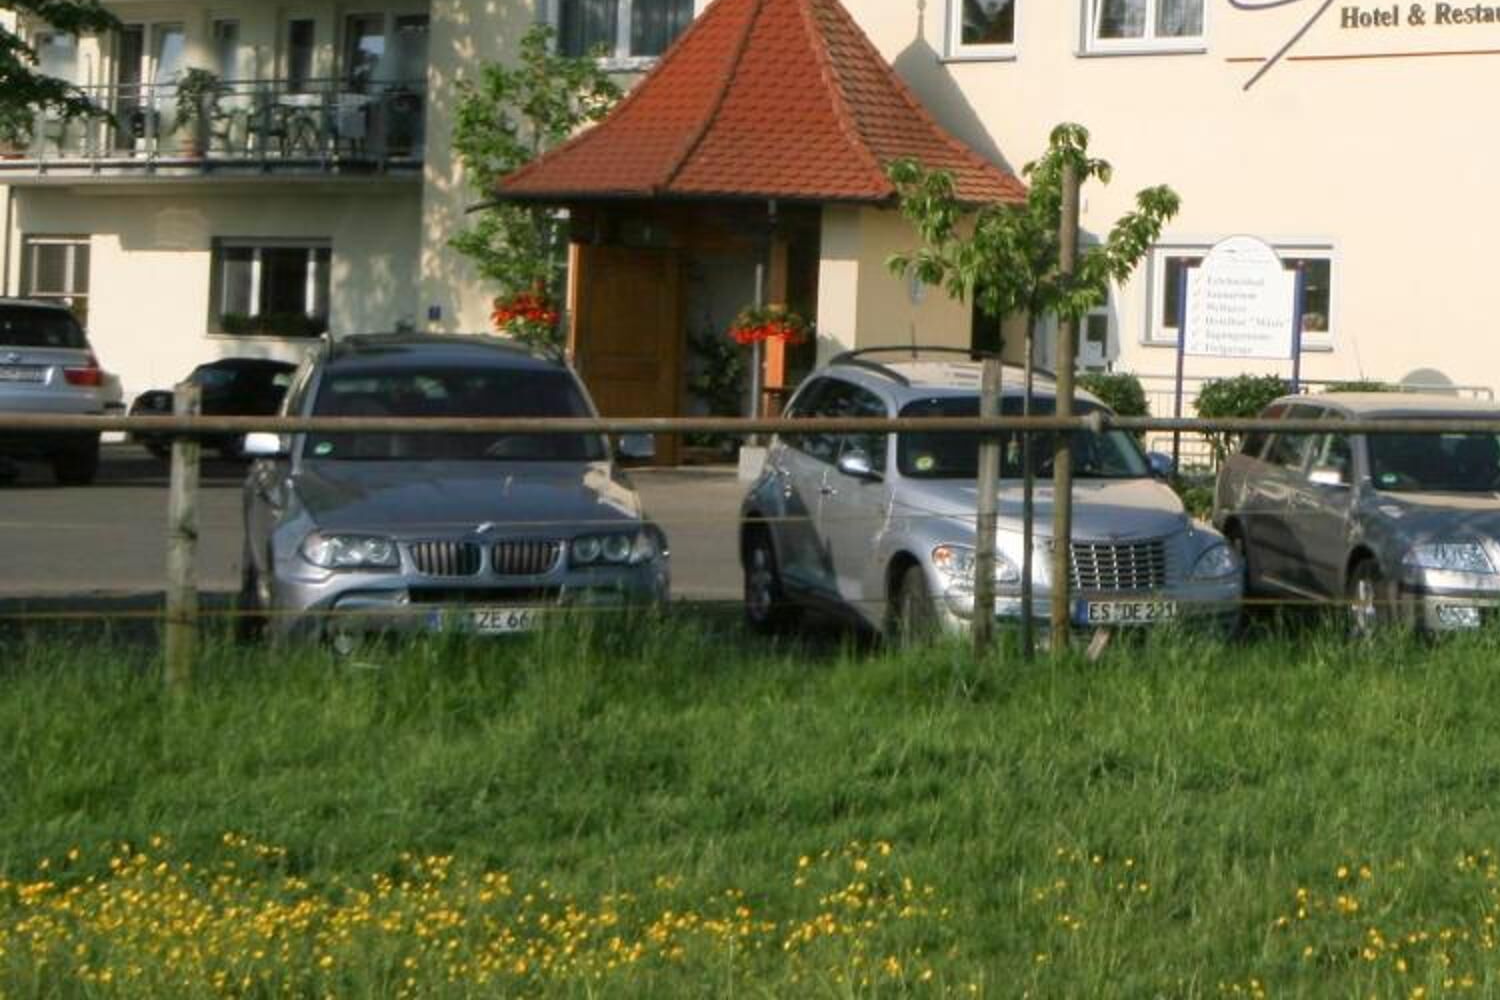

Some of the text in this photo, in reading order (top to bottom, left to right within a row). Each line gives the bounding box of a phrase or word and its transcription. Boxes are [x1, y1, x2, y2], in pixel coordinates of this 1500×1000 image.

[1340, 4, 1399, 29] Hotel
[1407, 3, 1426, 26] &
[1089, 602, 1111, 620] ES
